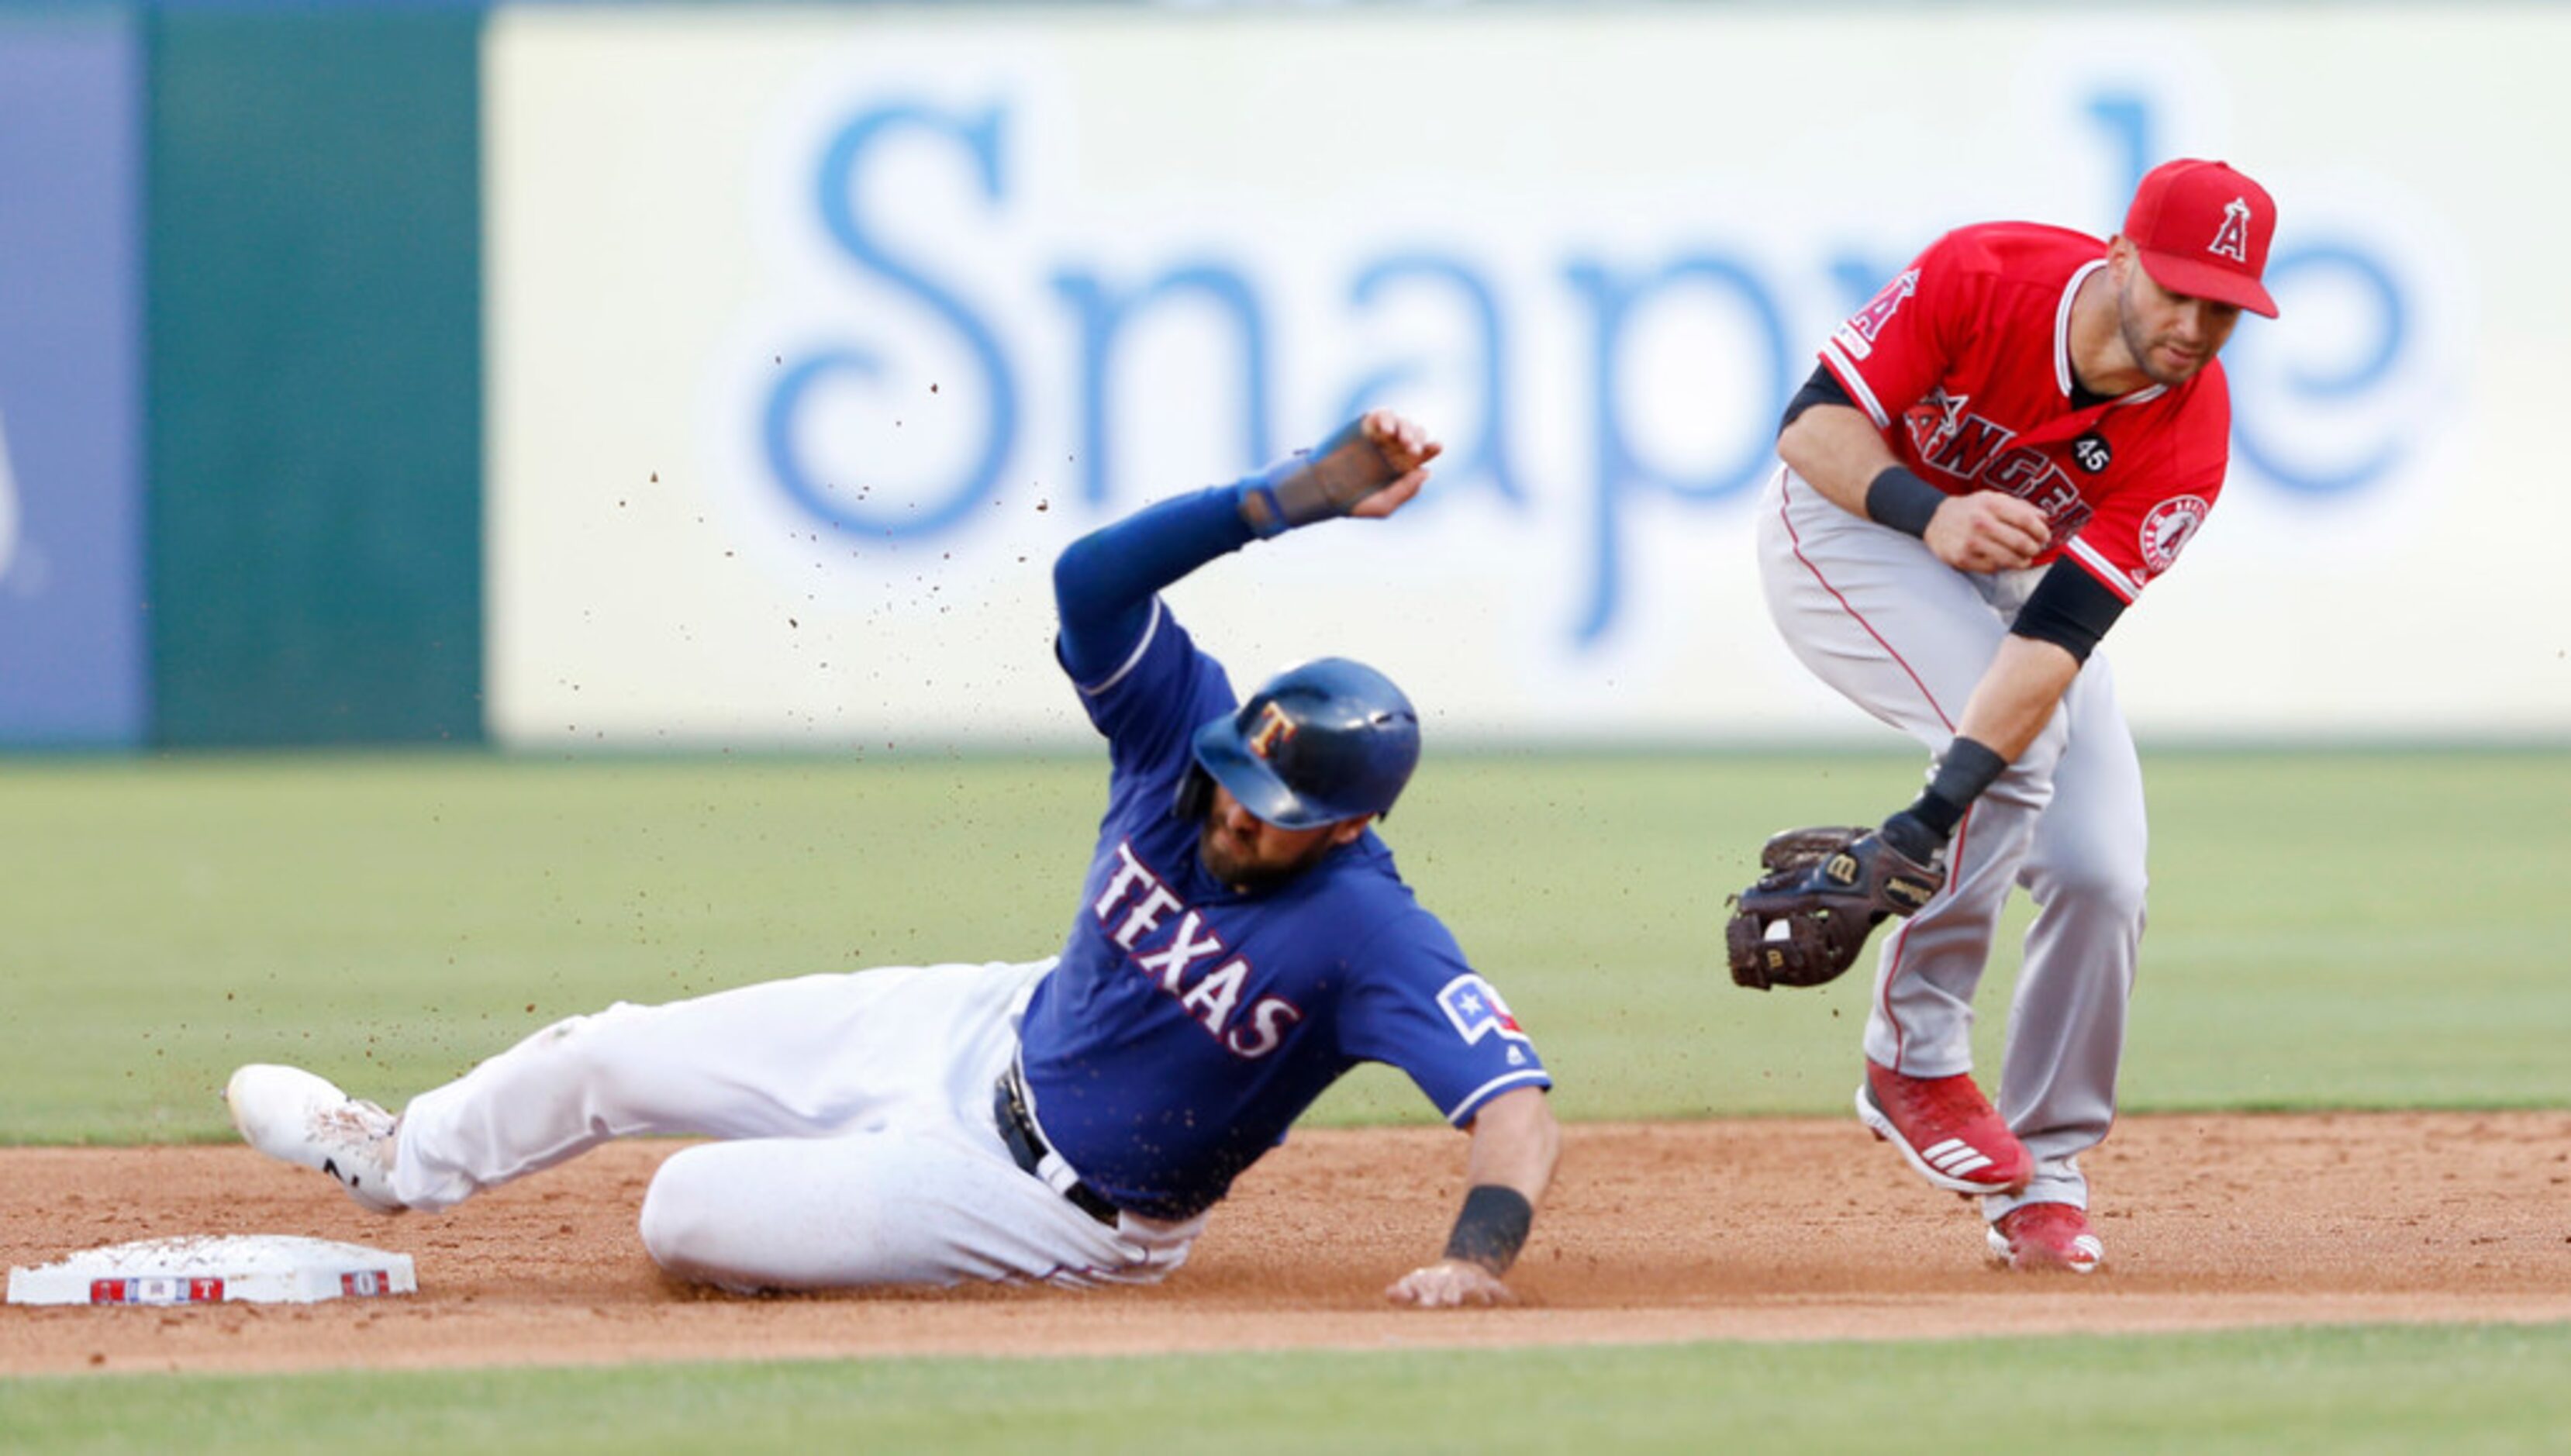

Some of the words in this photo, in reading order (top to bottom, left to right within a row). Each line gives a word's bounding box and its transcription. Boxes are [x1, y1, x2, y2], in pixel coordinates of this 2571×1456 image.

[2208, 197, 2251, 262] A
[764, 102, 2408, 643] Snape
[2076, 437, 2110, 471] 45
[1249, 699, 1300, 761] T
[1092, 836, 1304, 1058] TEXAS
